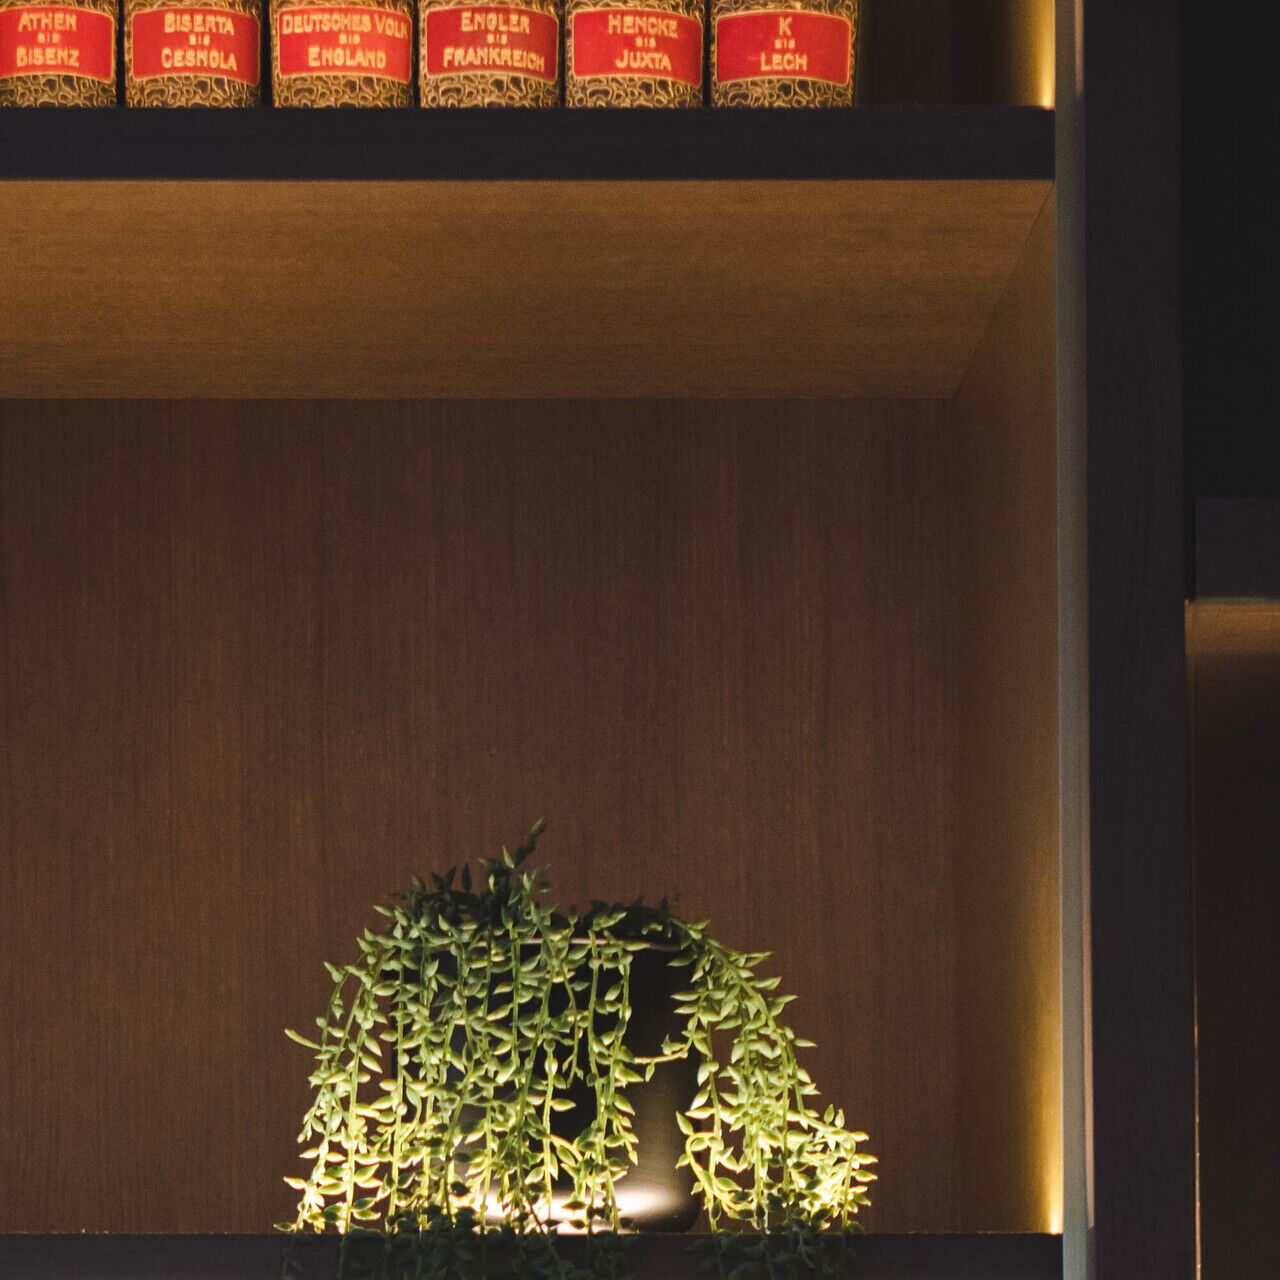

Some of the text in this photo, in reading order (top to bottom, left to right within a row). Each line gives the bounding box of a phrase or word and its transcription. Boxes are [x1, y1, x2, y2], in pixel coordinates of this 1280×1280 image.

[18, 12, 77, 32] ATHEN
[164, 13, 235, 35] BISERTA
[283, 13, 408, 39] DEUTSCHES VOLK
[461, 11, 530, 34] ENGLER
[608, 15, 678, 38] HENCKE
[778, 17, 792, 35] K
[16, 47, 79, 67] BISENZ
[161, 48, 237, 71] CESNOLA
[308, 47, 387, 68] ENGLAND
[443, 47, 545, 72] FRANKREICH
[615, 49, 671, 71] JUXTA
[761, 51, 807, 71] LECH
